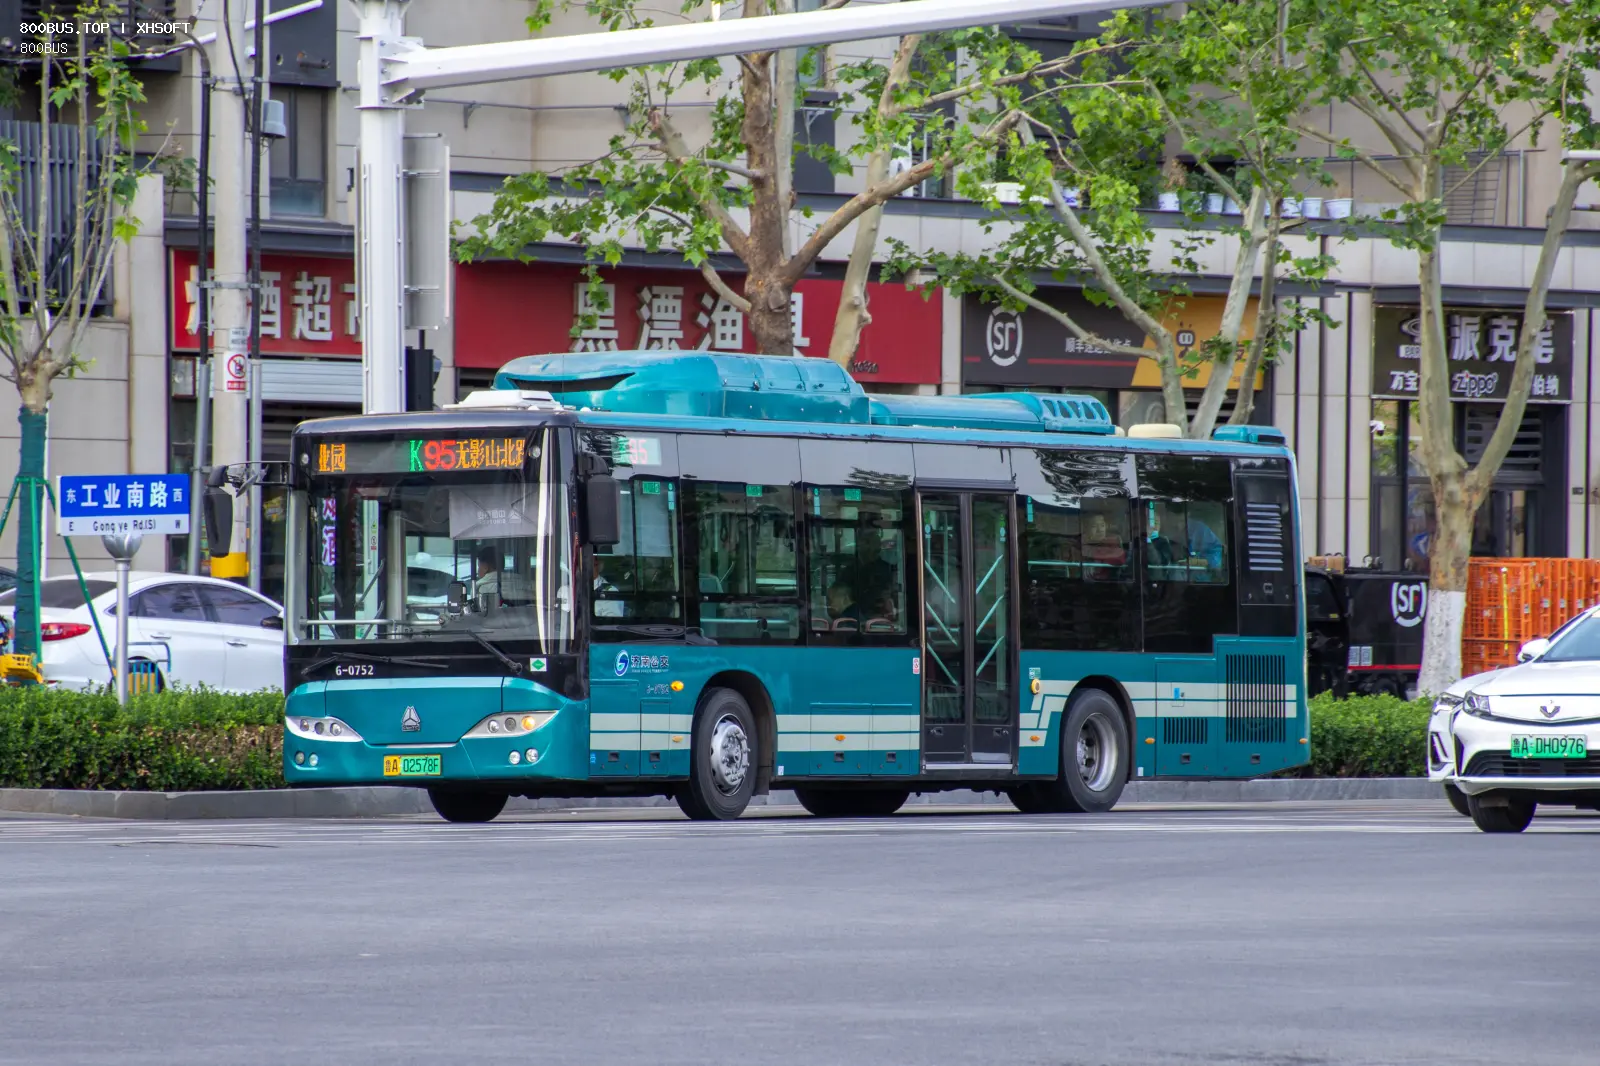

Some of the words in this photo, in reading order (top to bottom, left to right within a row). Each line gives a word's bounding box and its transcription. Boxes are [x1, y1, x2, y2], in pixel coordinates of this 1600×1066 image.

[1390, 371, 1421, 391] 万宝
[1452, 371, 1498, 396] Zippo
[409, 440, 456, 472] K95
[66, 488, 76, 504] 东
[81, 481, 168, 508] 工业南路
[173, 488, 183, 502] 西
[69, 521, 74, 531] E
[335, 665, 374, 676] 6-0752
[631, 655, 669, 668] 济南公交
